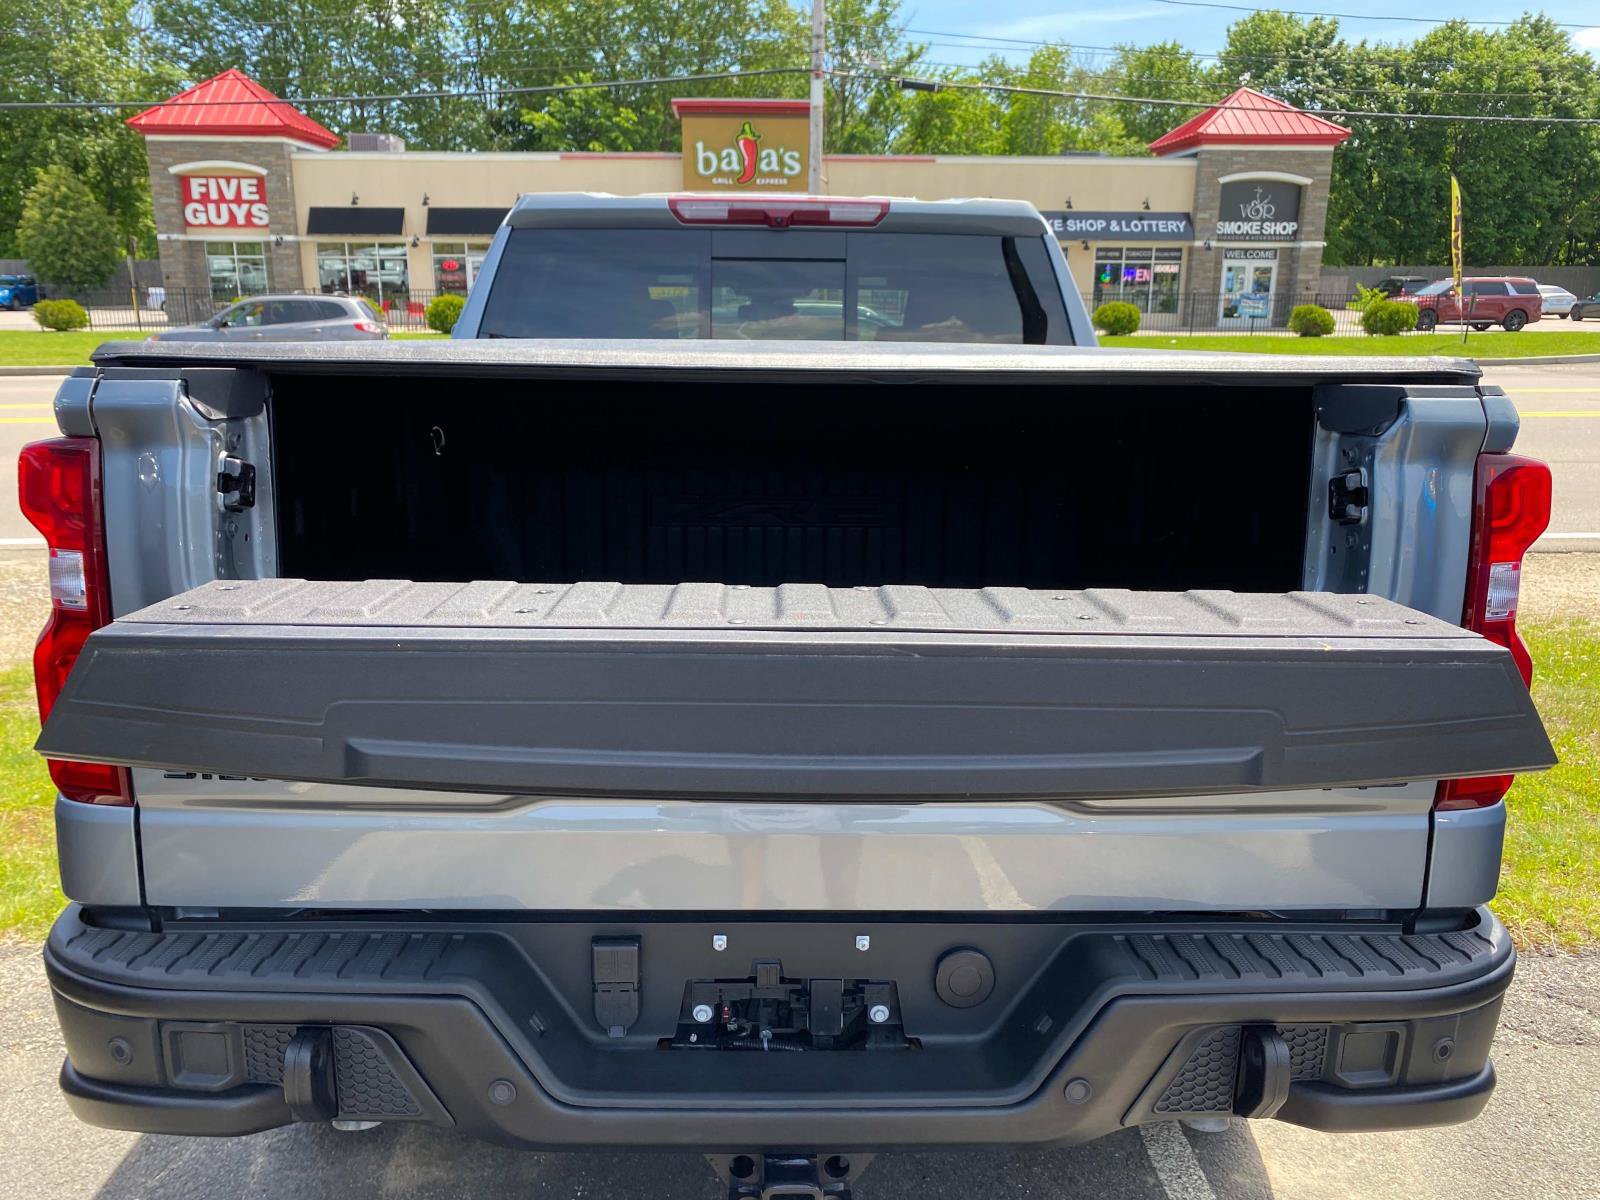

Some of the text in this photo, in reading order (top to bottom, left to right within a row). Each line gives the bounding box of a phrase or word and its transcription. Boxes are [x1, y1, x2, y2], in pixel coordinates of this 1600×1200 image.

[189, 177, 260, 201] FIVE
[184, 202, 270, 226] GUYS
[1066, 219, 1106, 232] SHOP
[1109, 220, 1120, 232] &
[1121, 220, 1186, 232] LOTTERY
[1216, 221, 1298, 235] SMOKE SHOP
[1225, 249, 1276, 259] WELCOME
